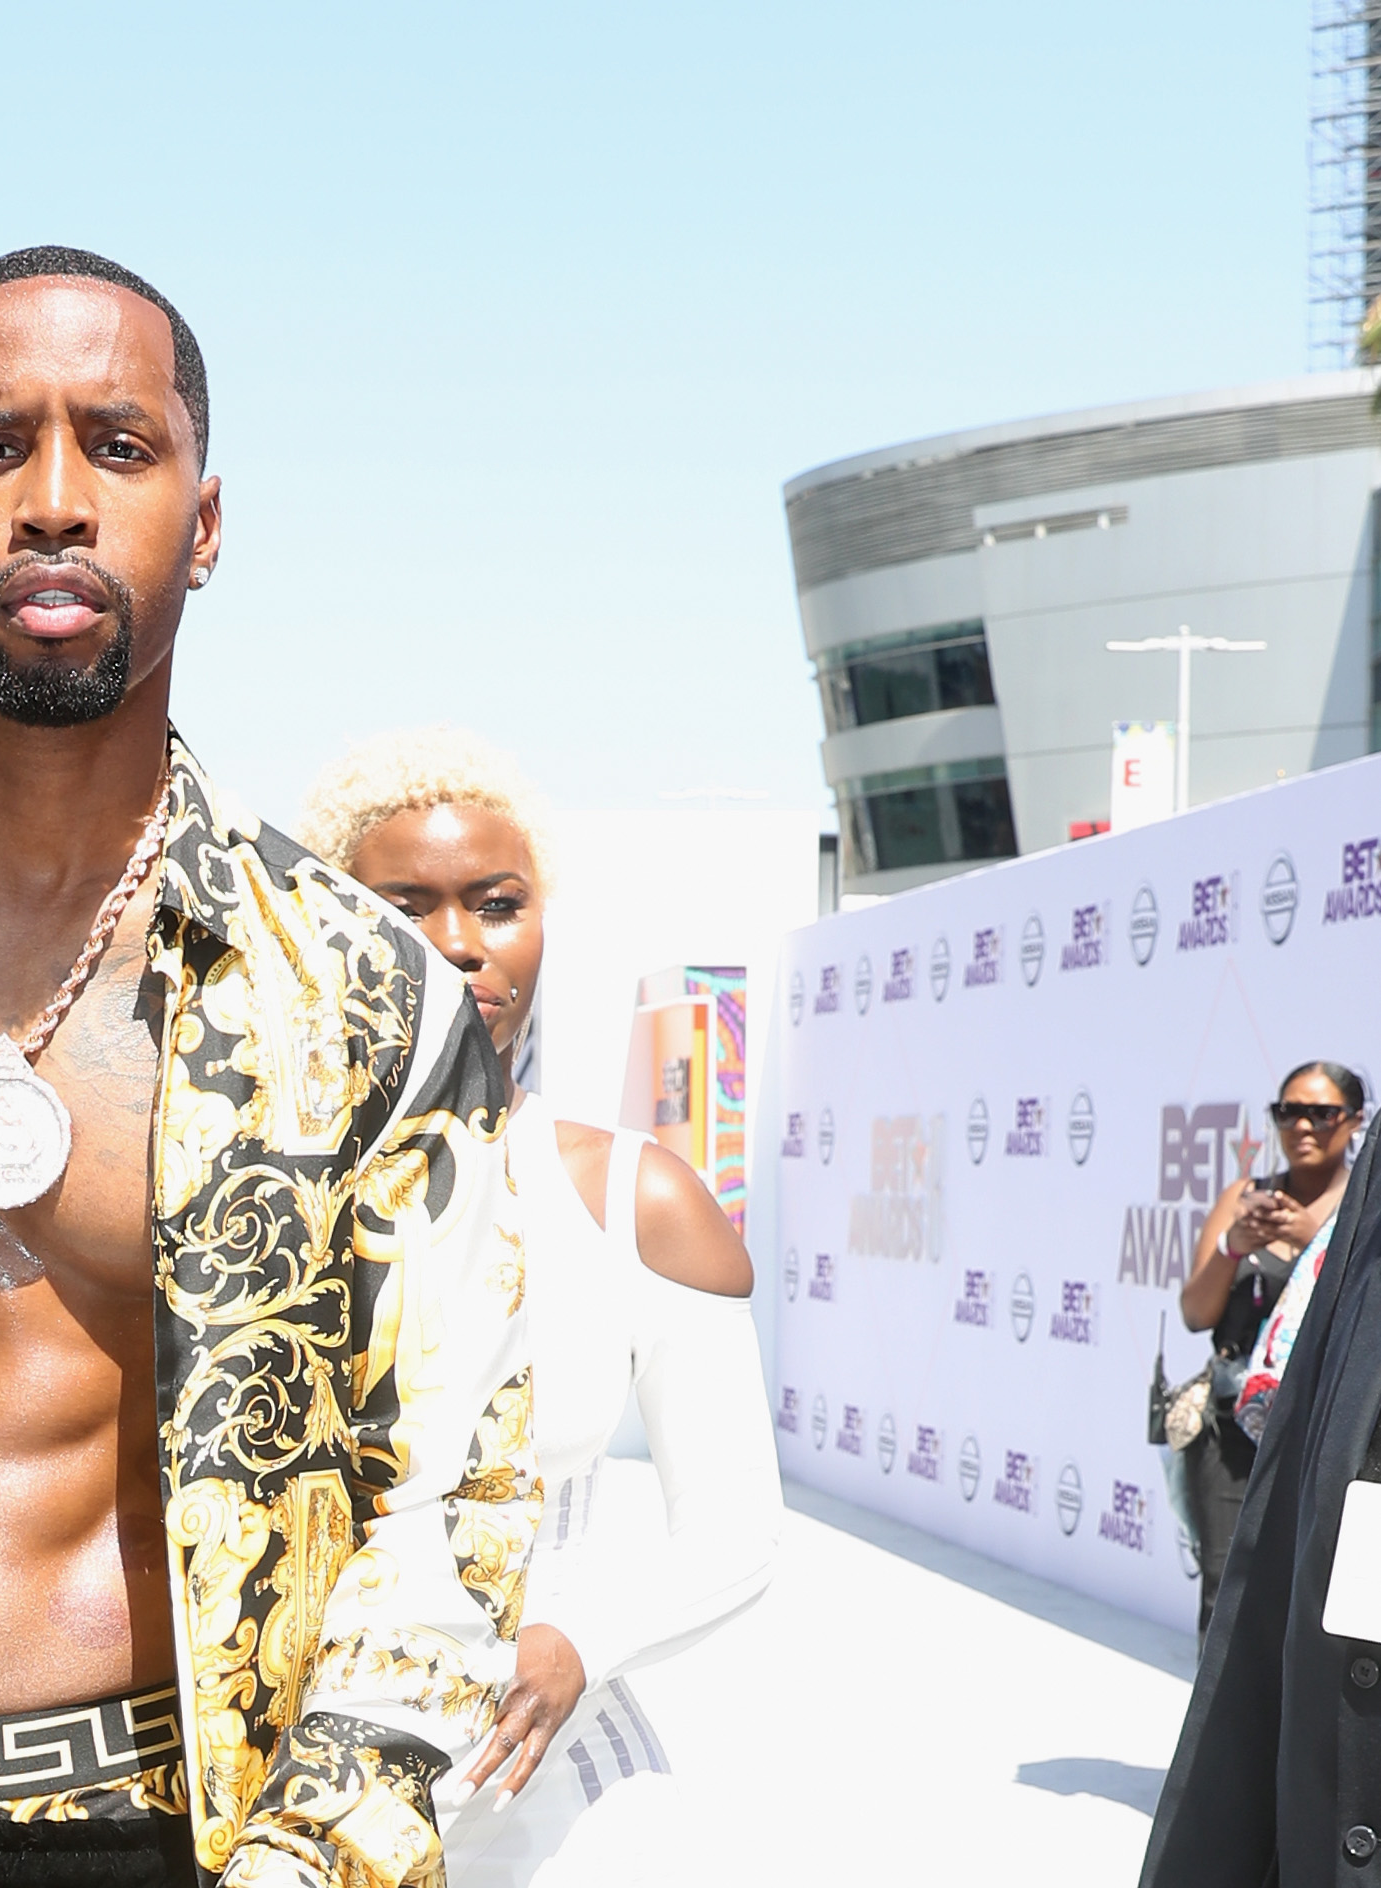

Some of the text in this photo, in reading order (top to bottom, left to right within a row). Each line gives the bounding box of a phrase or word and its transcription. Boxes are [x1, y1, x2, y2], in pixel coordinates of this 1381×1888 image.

[1342, 837, 1379, 884] BET
[1192, 875, 1223, 917] BET
[1074, 904, 1098, 941] BET
[872, 1115, 920, 1195] BET
[1113, 1479, 1140, 1516] BET
